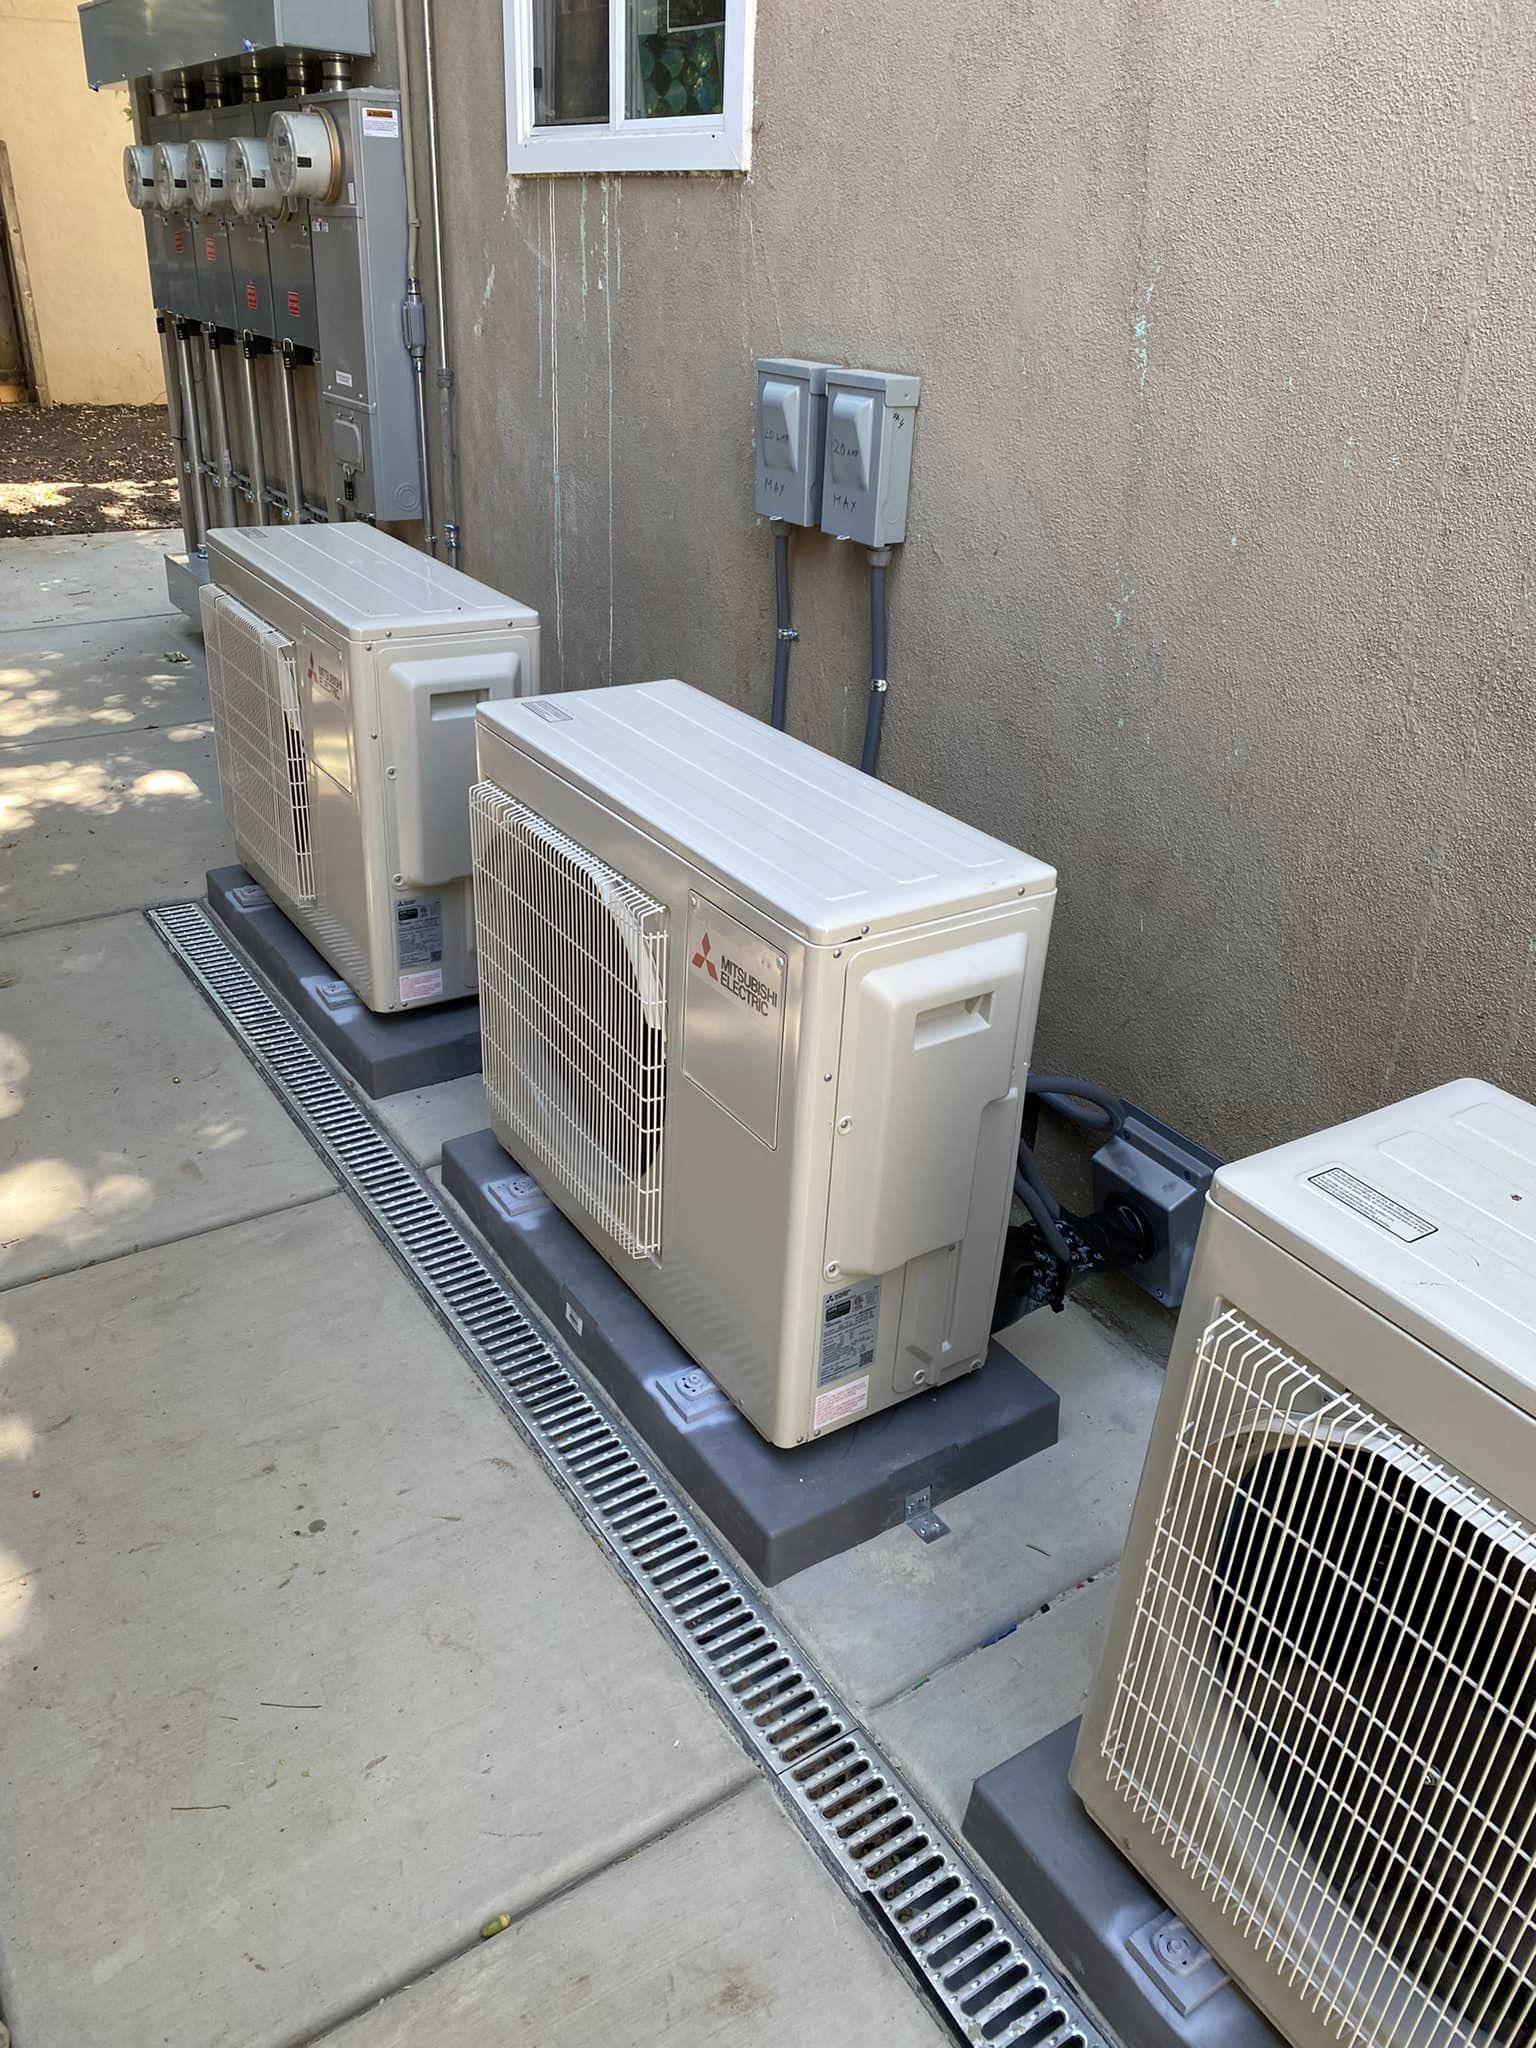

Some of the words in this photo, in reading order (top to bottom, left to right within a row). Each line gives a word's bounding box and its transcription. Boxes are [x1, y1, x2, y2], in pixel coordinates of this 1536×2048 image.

[831, 438, 846, 456] 20
[720, 955, 778, 1008] MITSUBISHI
[720, 971, 769, 1017] ELECTRIC
